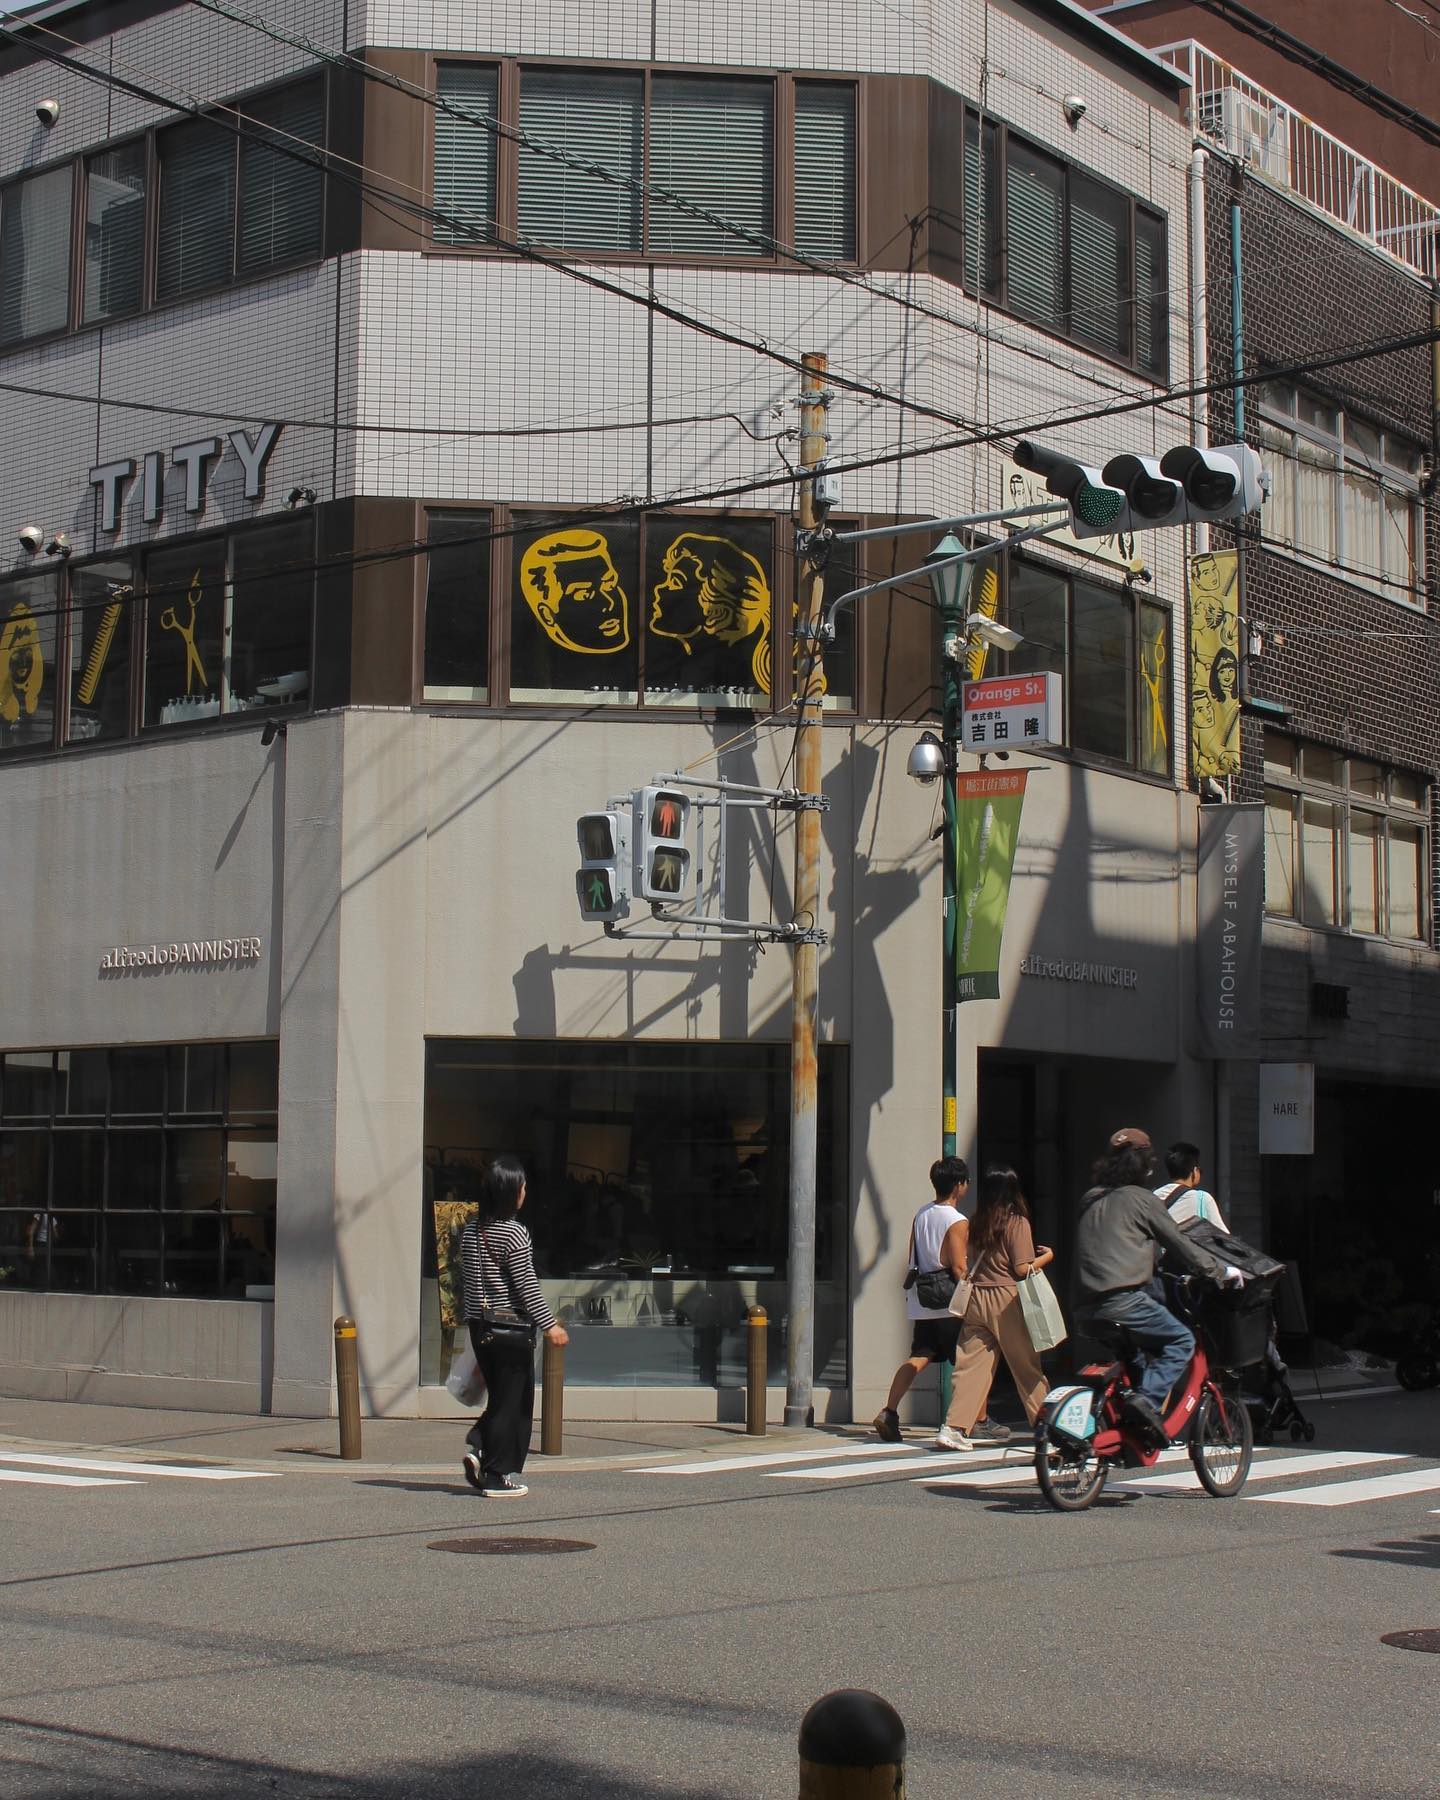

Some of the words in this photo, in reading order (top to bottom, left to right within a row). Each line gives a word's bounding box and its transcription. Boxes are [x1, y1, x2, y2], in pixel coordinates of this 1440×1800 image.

[89, 423, 283, 533] TITY
[968, 687, 1021, 702] Orange
[1025, 682, 1043, 696] St.
[971, 711, 1002, 722] 株式会社
[102, 936, 262, 969] alfredoBANNISTER
[1020, 954, 1138, 987] alfredoBANNISTER
[1218, 919, 1237, 1030] ABAHOUSE
[1272, 1102, 1299, 1116] HARE
